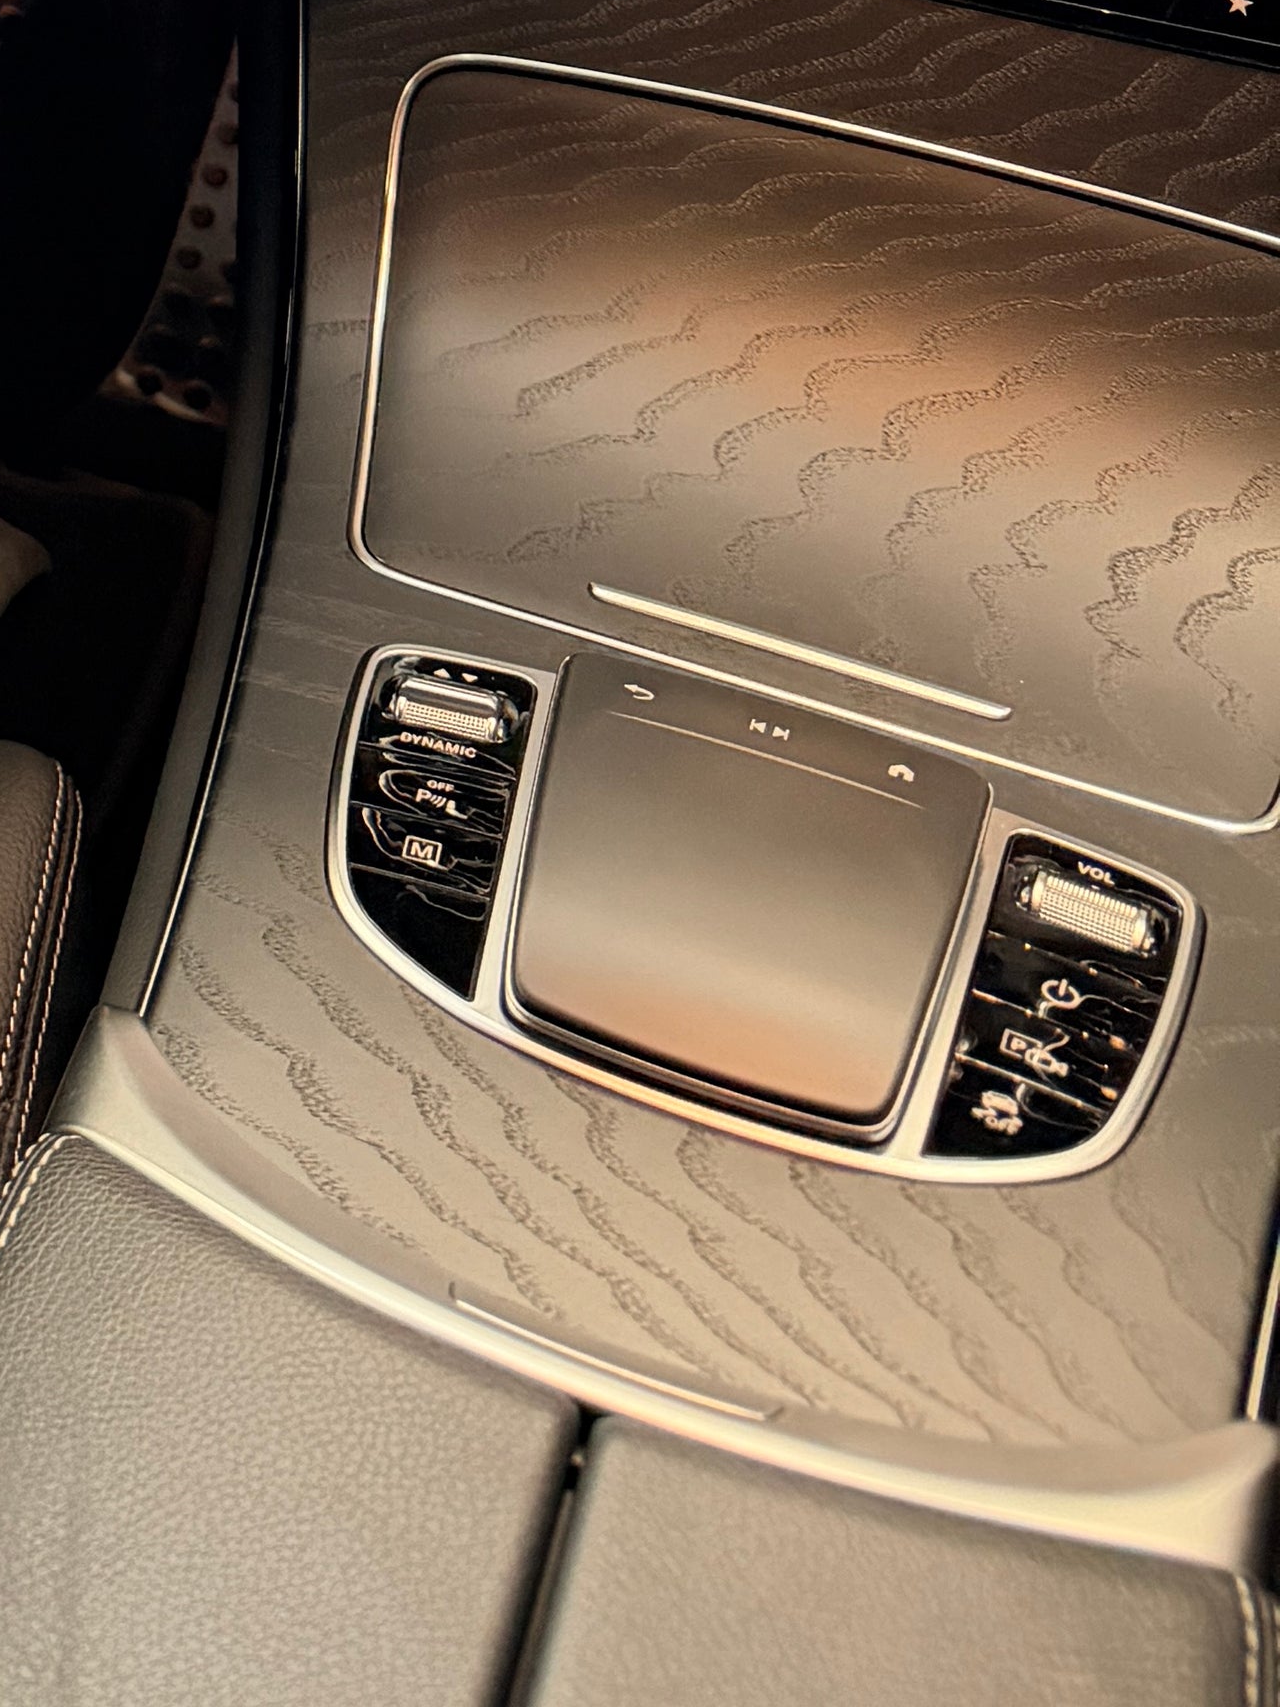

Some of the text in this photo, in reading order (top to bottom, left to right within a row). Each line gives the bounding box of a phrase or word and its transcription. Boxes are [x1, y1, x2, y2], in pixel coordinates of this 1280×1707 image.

[399, 730, 478, 759] DYNAMIC
[426, 778, 455, 793] OFF
[1077, 860, 1117, 886] VOL
